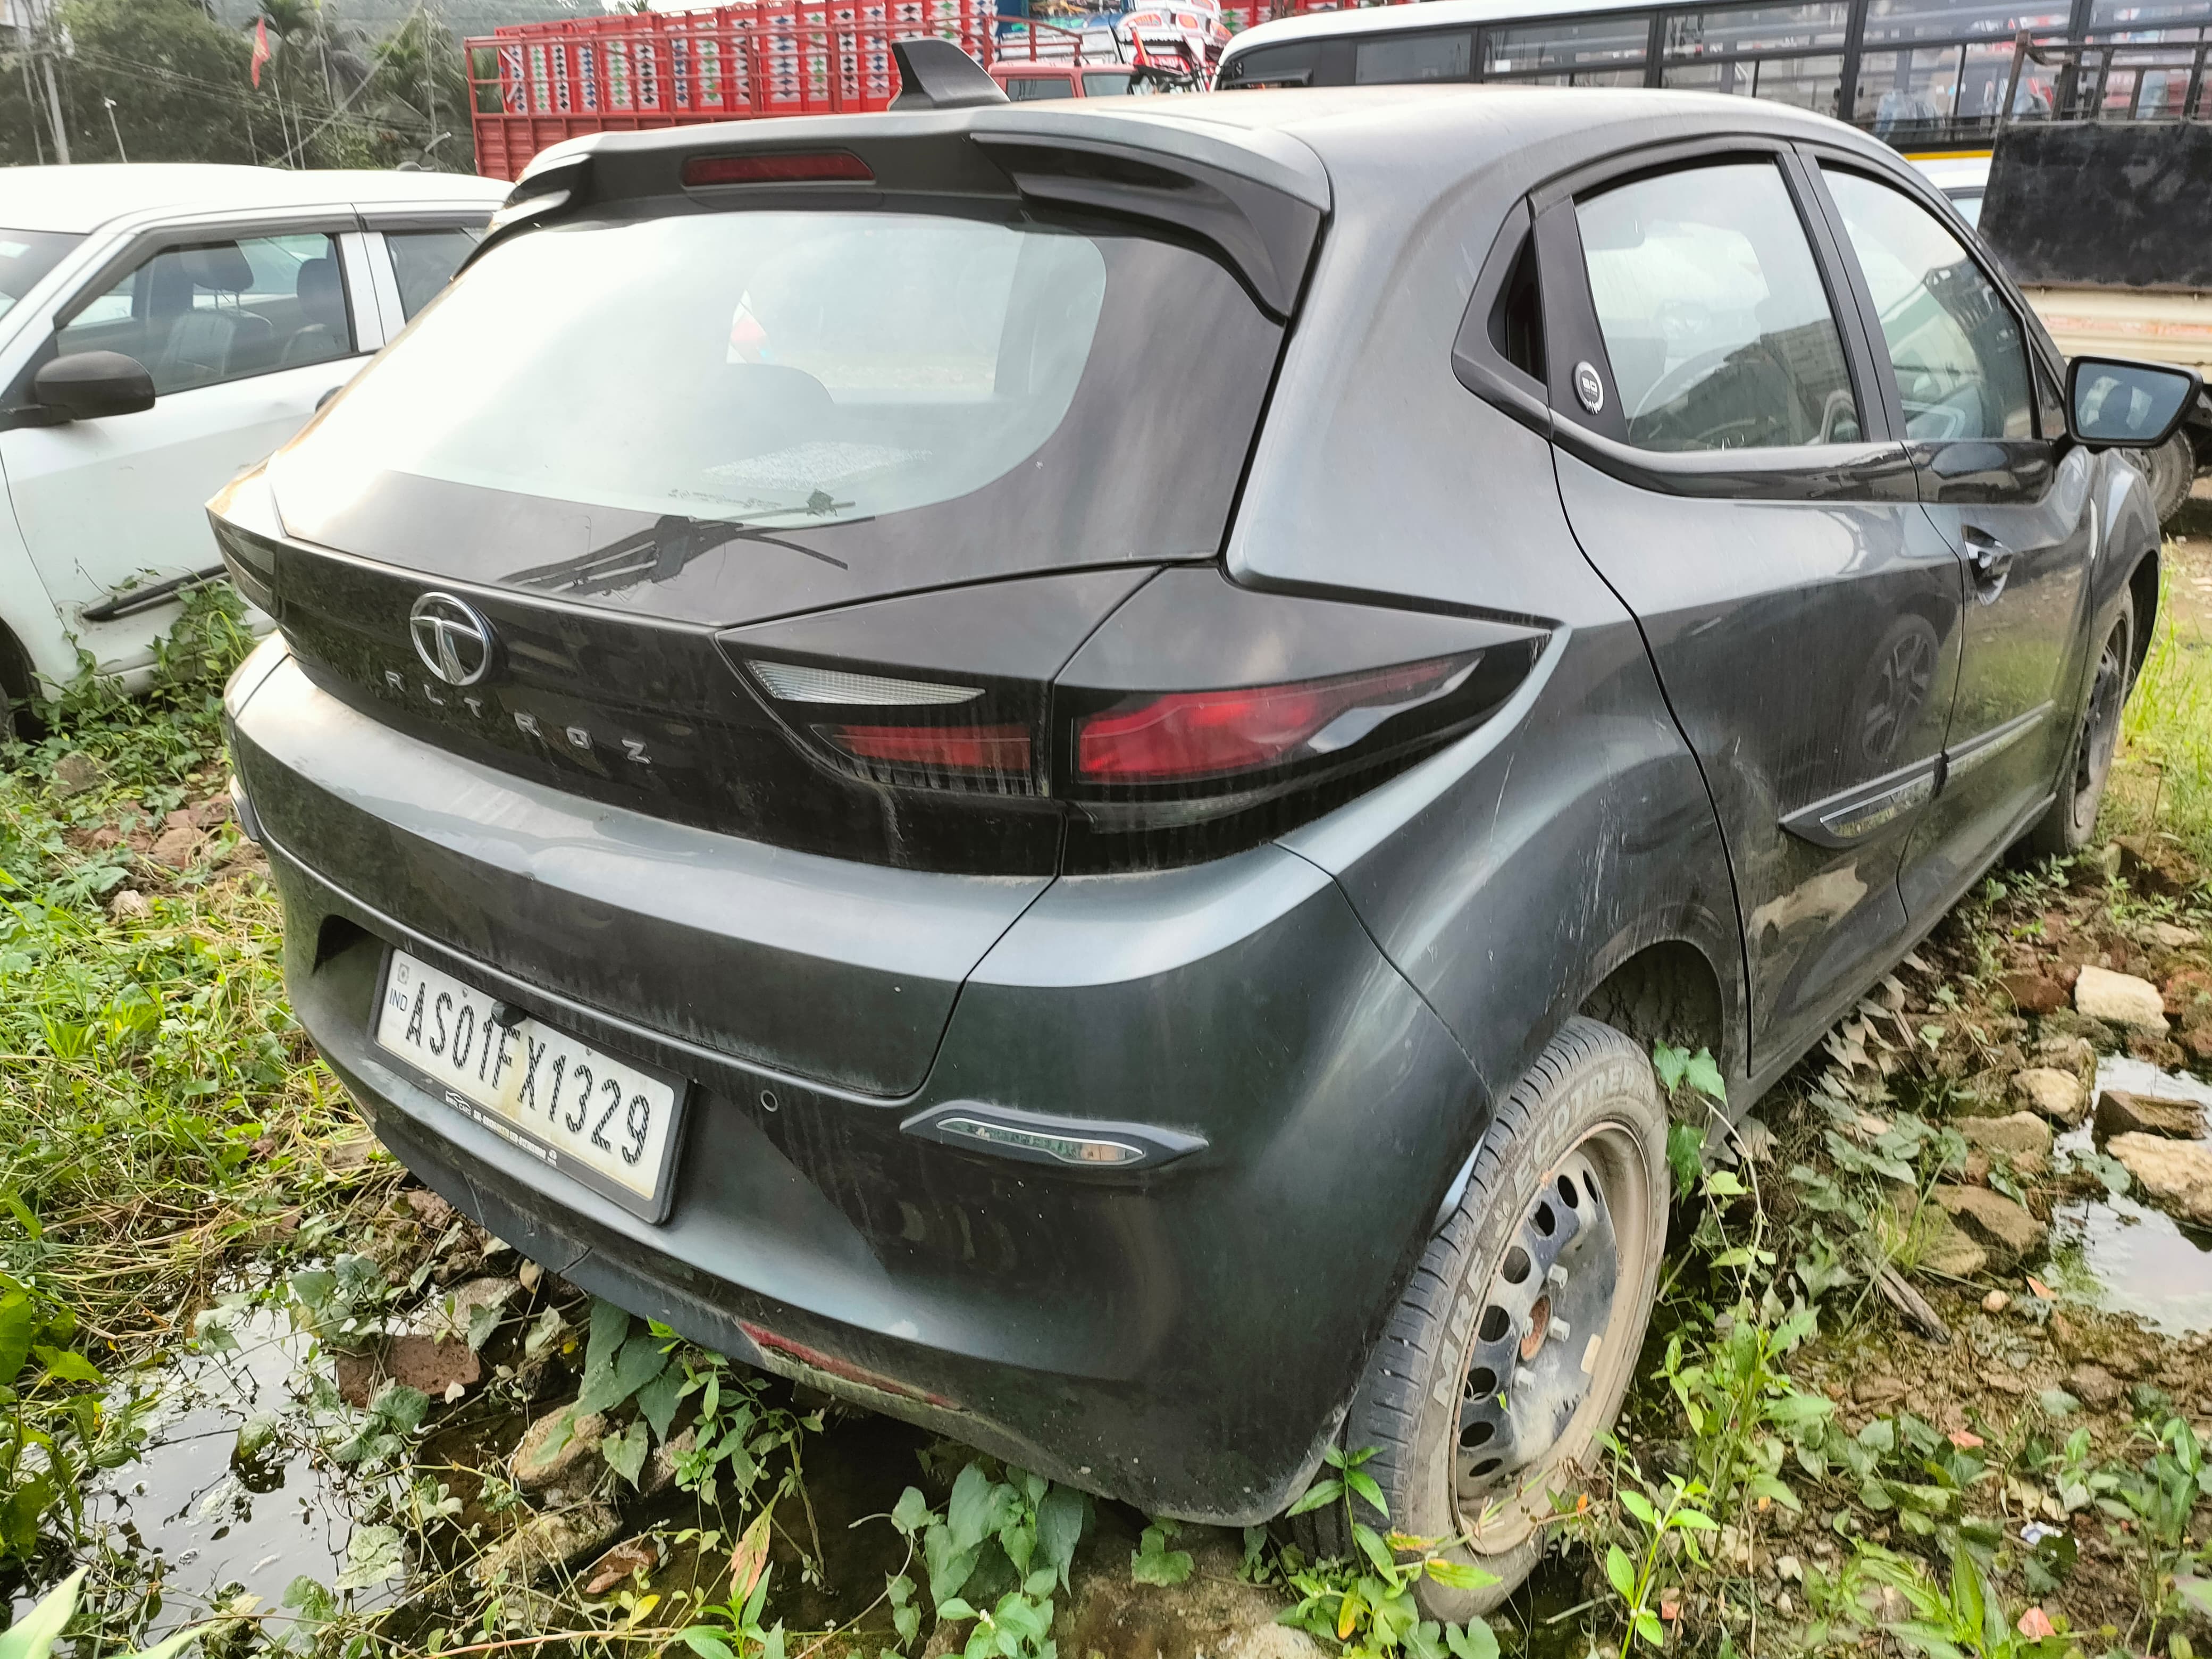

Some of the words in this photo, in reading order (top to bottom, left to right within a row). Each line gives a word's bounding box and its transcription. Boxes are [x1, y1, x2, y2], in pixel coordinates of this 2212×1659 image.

[385, 670, 651, 764] ALTROZ
[389, 988, 408, 1011] IND
[405, 982, 650, 1167] AS01FX1329
[1432, 1247, 1485, 1408] MRF
